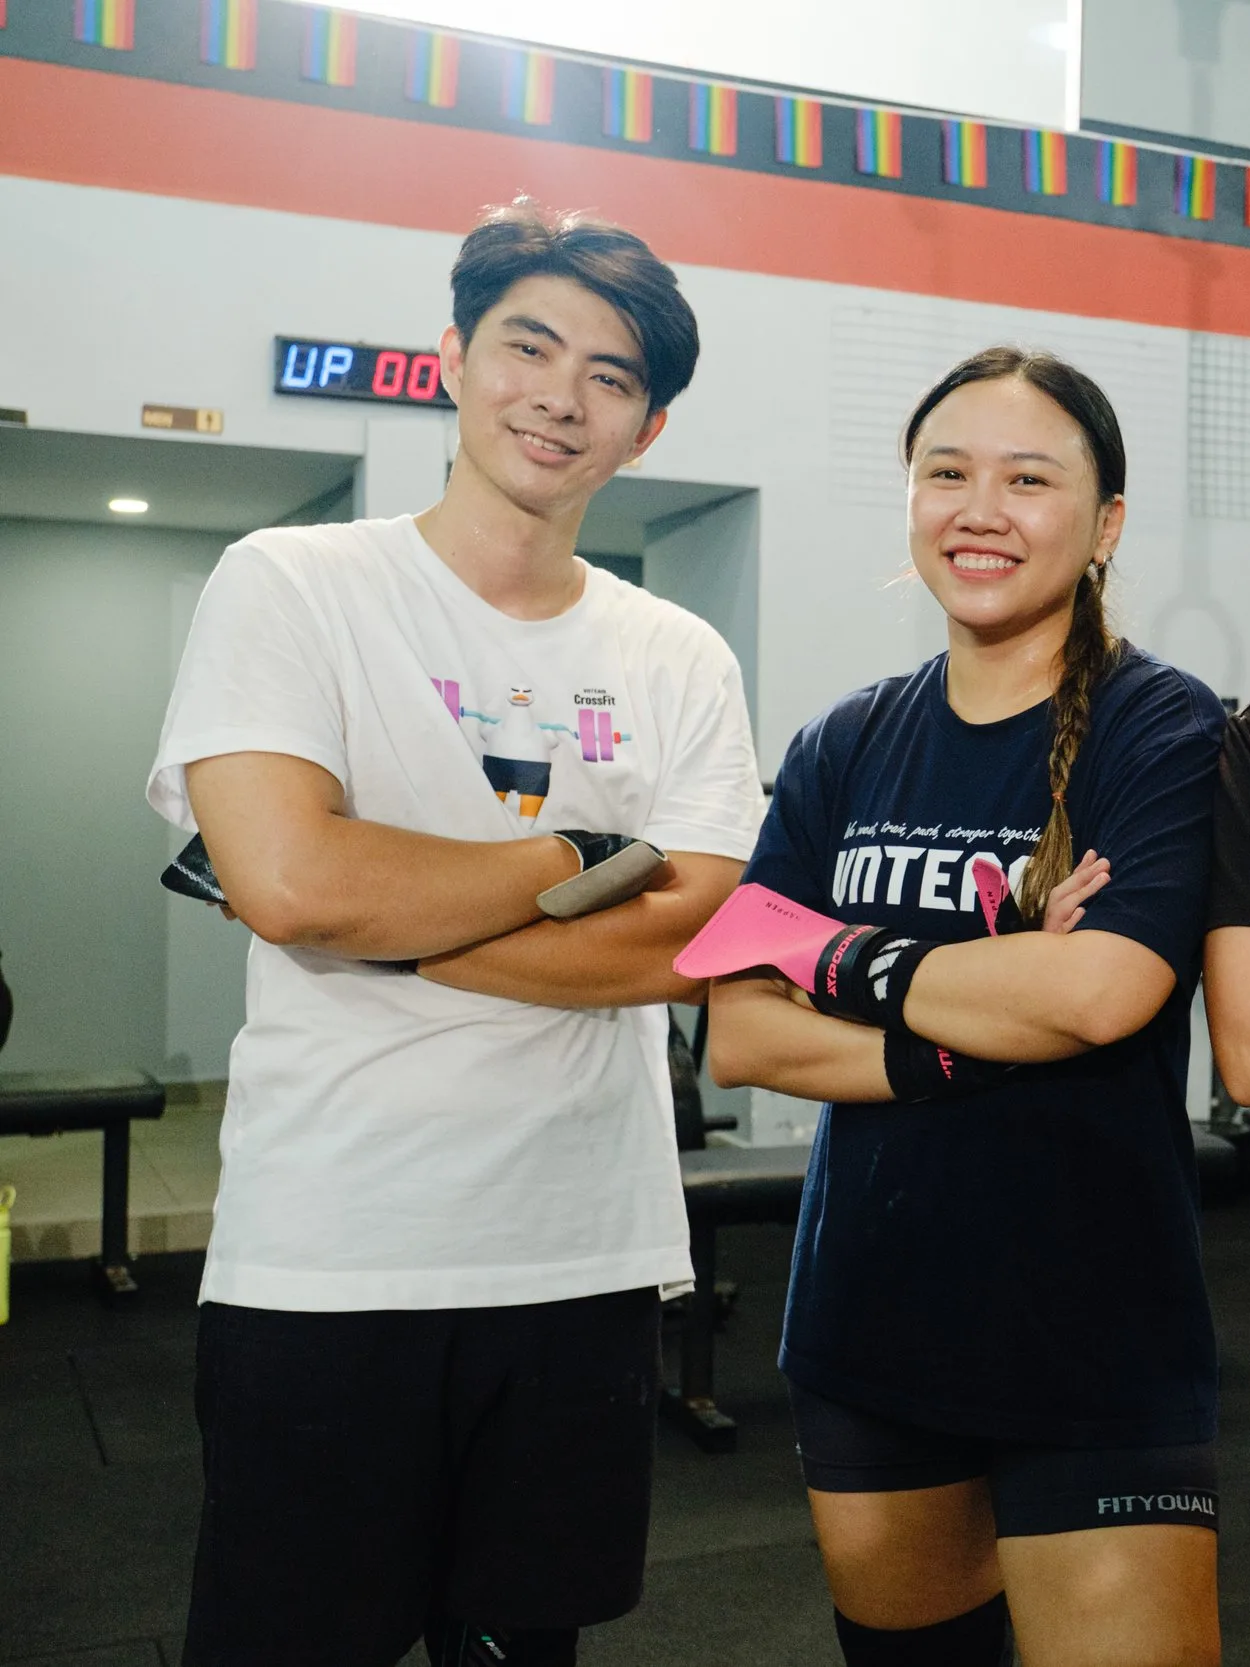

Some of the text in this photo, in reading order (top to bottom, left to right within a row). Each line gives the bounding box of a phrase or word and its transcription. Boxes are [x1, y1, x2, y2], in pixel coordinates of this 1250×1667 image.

[281, 344, 441, 399] UP 00
[574, 694, 616, 706] CrossFit
[945, 826, 995, 844] stronger
[997, 826, 1043, 845] togeth
[1097, 1494, 1216, 1516] FITYOUALL
